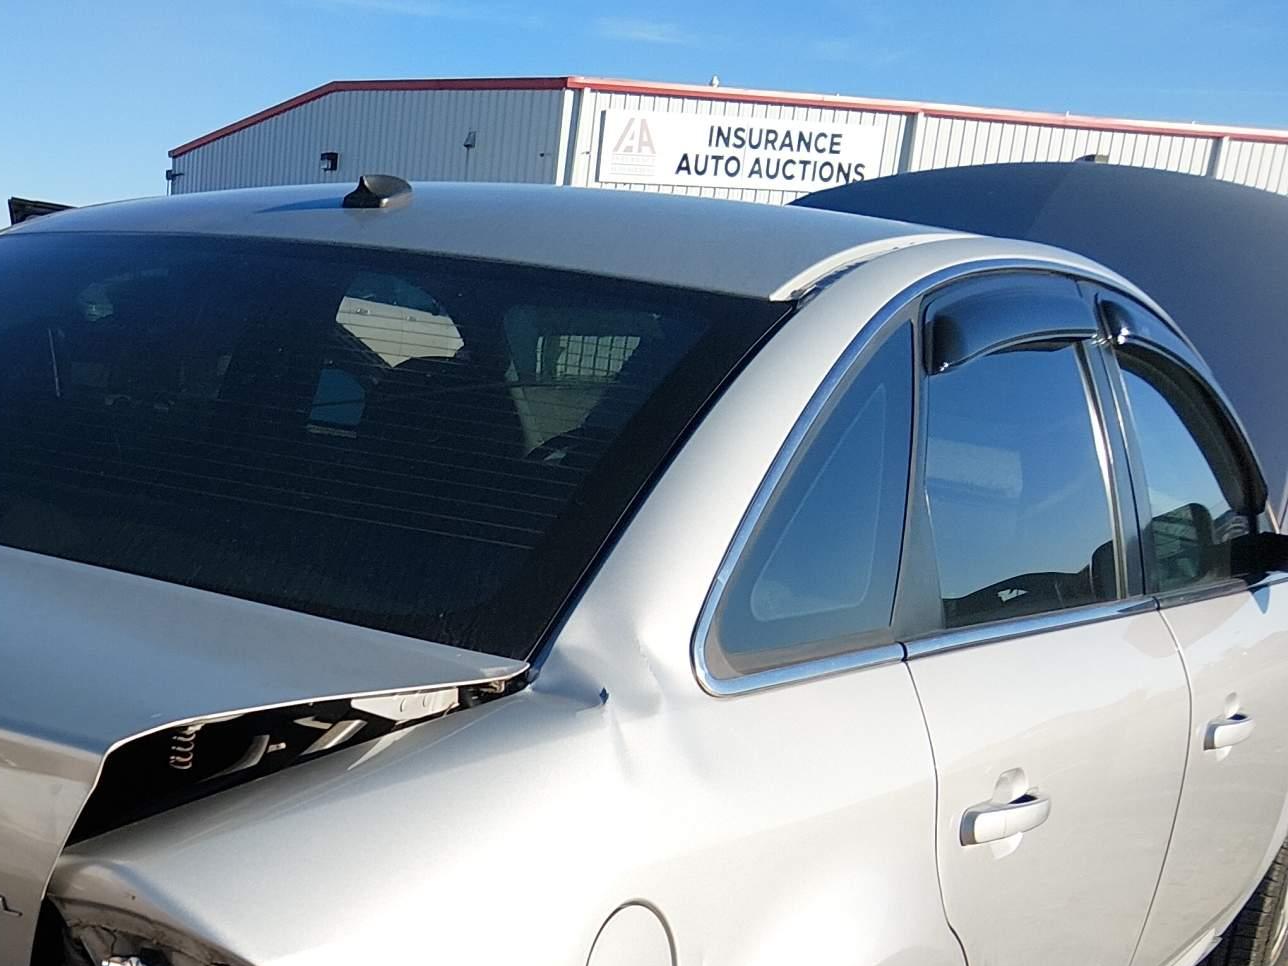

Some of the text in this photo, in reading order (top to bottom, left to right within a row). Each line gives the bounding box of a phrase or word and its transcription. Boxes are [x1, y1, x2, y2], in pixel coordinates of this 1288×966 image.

[708, 125, 843, 154] INSURANCE
[675, 153, 866, 184] AUTO AUCTIONS
